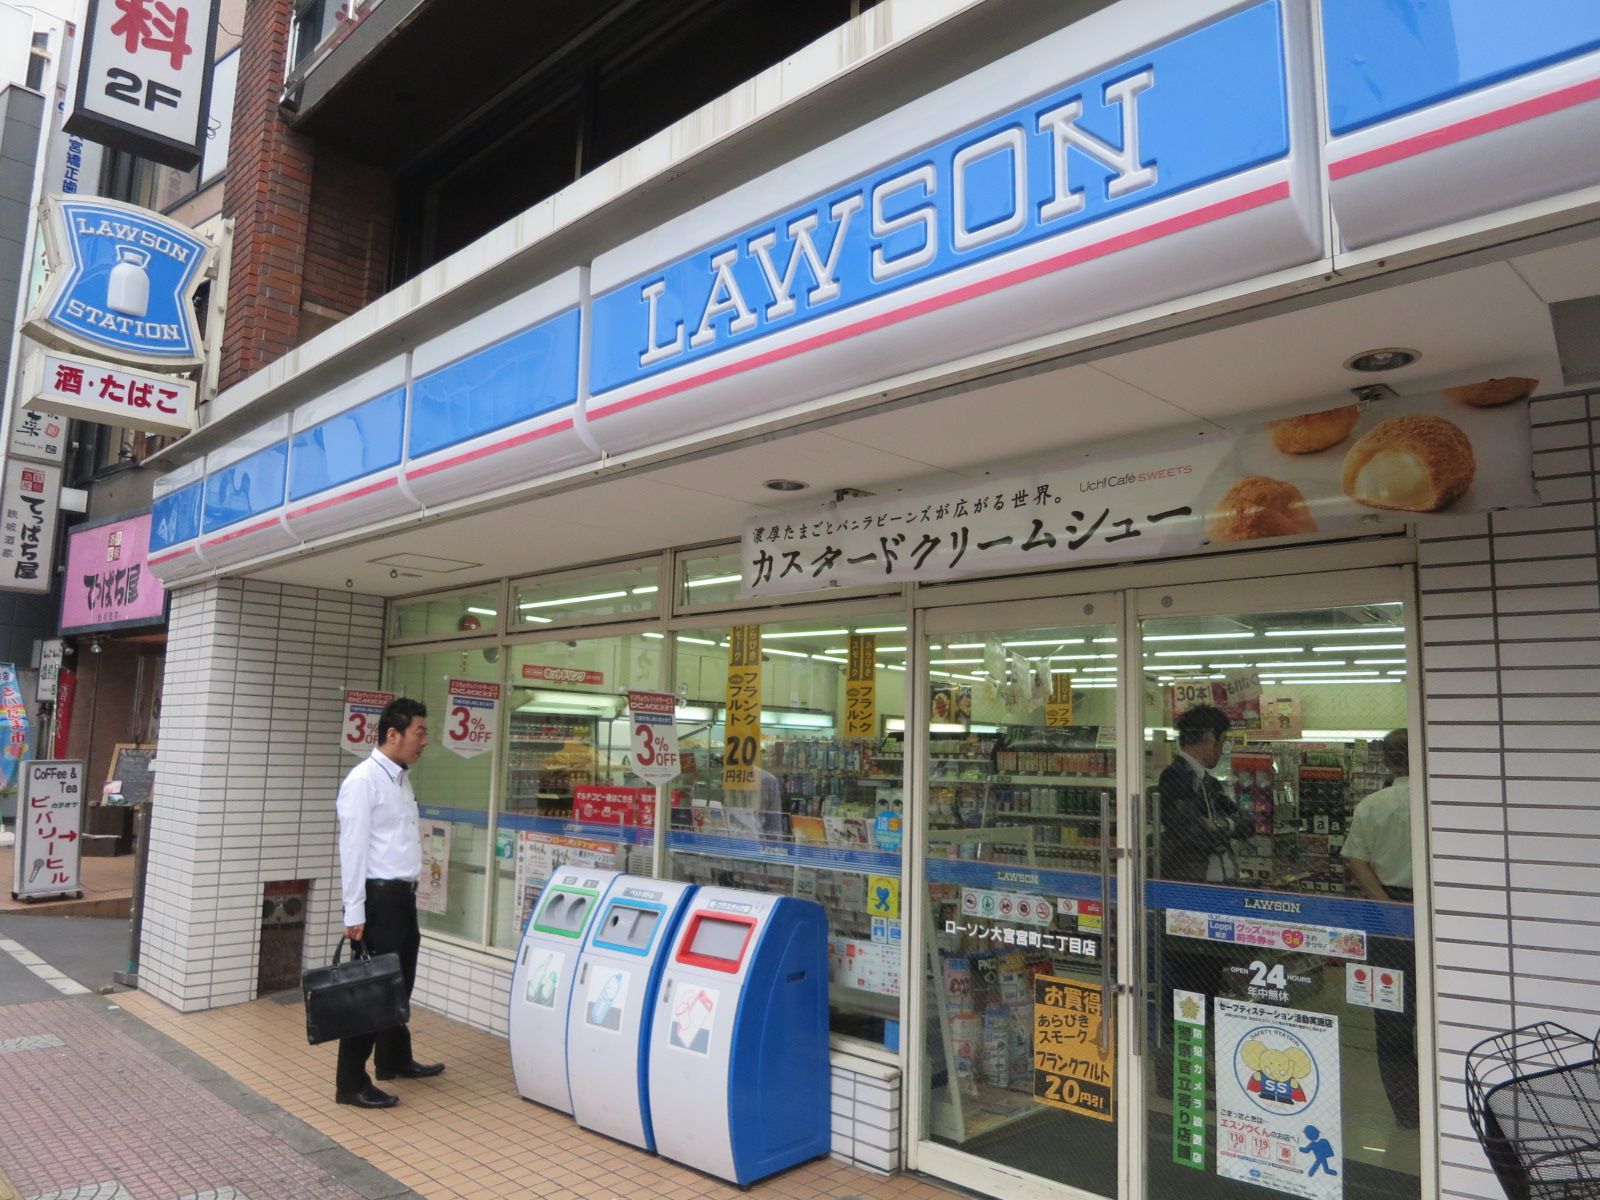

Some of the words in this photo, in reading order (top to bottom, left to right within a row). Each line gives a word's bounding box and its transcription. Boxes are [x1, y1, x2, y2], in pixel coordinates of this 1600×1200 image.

[104, 67, 182, 112] 2F
[62, 133, 84, 194] 宮矯正歯
[639, 64, 1159, 368] LAWSON
[77, 217, 190, 263] LAWSON
[66, 299, 181, 341] STATION
[54, 364, 179, 415] 酒・たばこ
[1138, 464, 1193, 483] SWEETS
[751, 505, 1193, 588] カスタードクリームシュー
[2, 687, 25, 744] さいたま市
[469, 730, 492, 743] OFF
[656, 753, 677, 767] OFF
[727, 735, 758, 767] 20
[70, 767, 77, 779] &
[59, 781, 78, 793] Tea
[997, 871, 1040, 885] LAWSON
[1243, 898, 1301, 913] LAWSON
[1209, 920, 1233, 931] Loppi
[945, 920, 1096, 957] ローソン大宮宮町二丁目店
[1230, 966, 1249, 974] OPEN
[1249, 961, 1287, 989] 24
[1287, 975, 1312, 984] HOURS
[1248, 985, 1290, 1003] 年中無休
[1038, 1014, 1089, 1028] あらびき
[1219, 1002, 1333, 1028] セーフティステーション活動実施店
[1039, 1029, 1088, 1044] スモーク
[1036, 1050, 1110, 1082] フランクフルト
[1230, 1132, 1244, 1144] 110
[1254, 1137, 1268, 1149] 119
